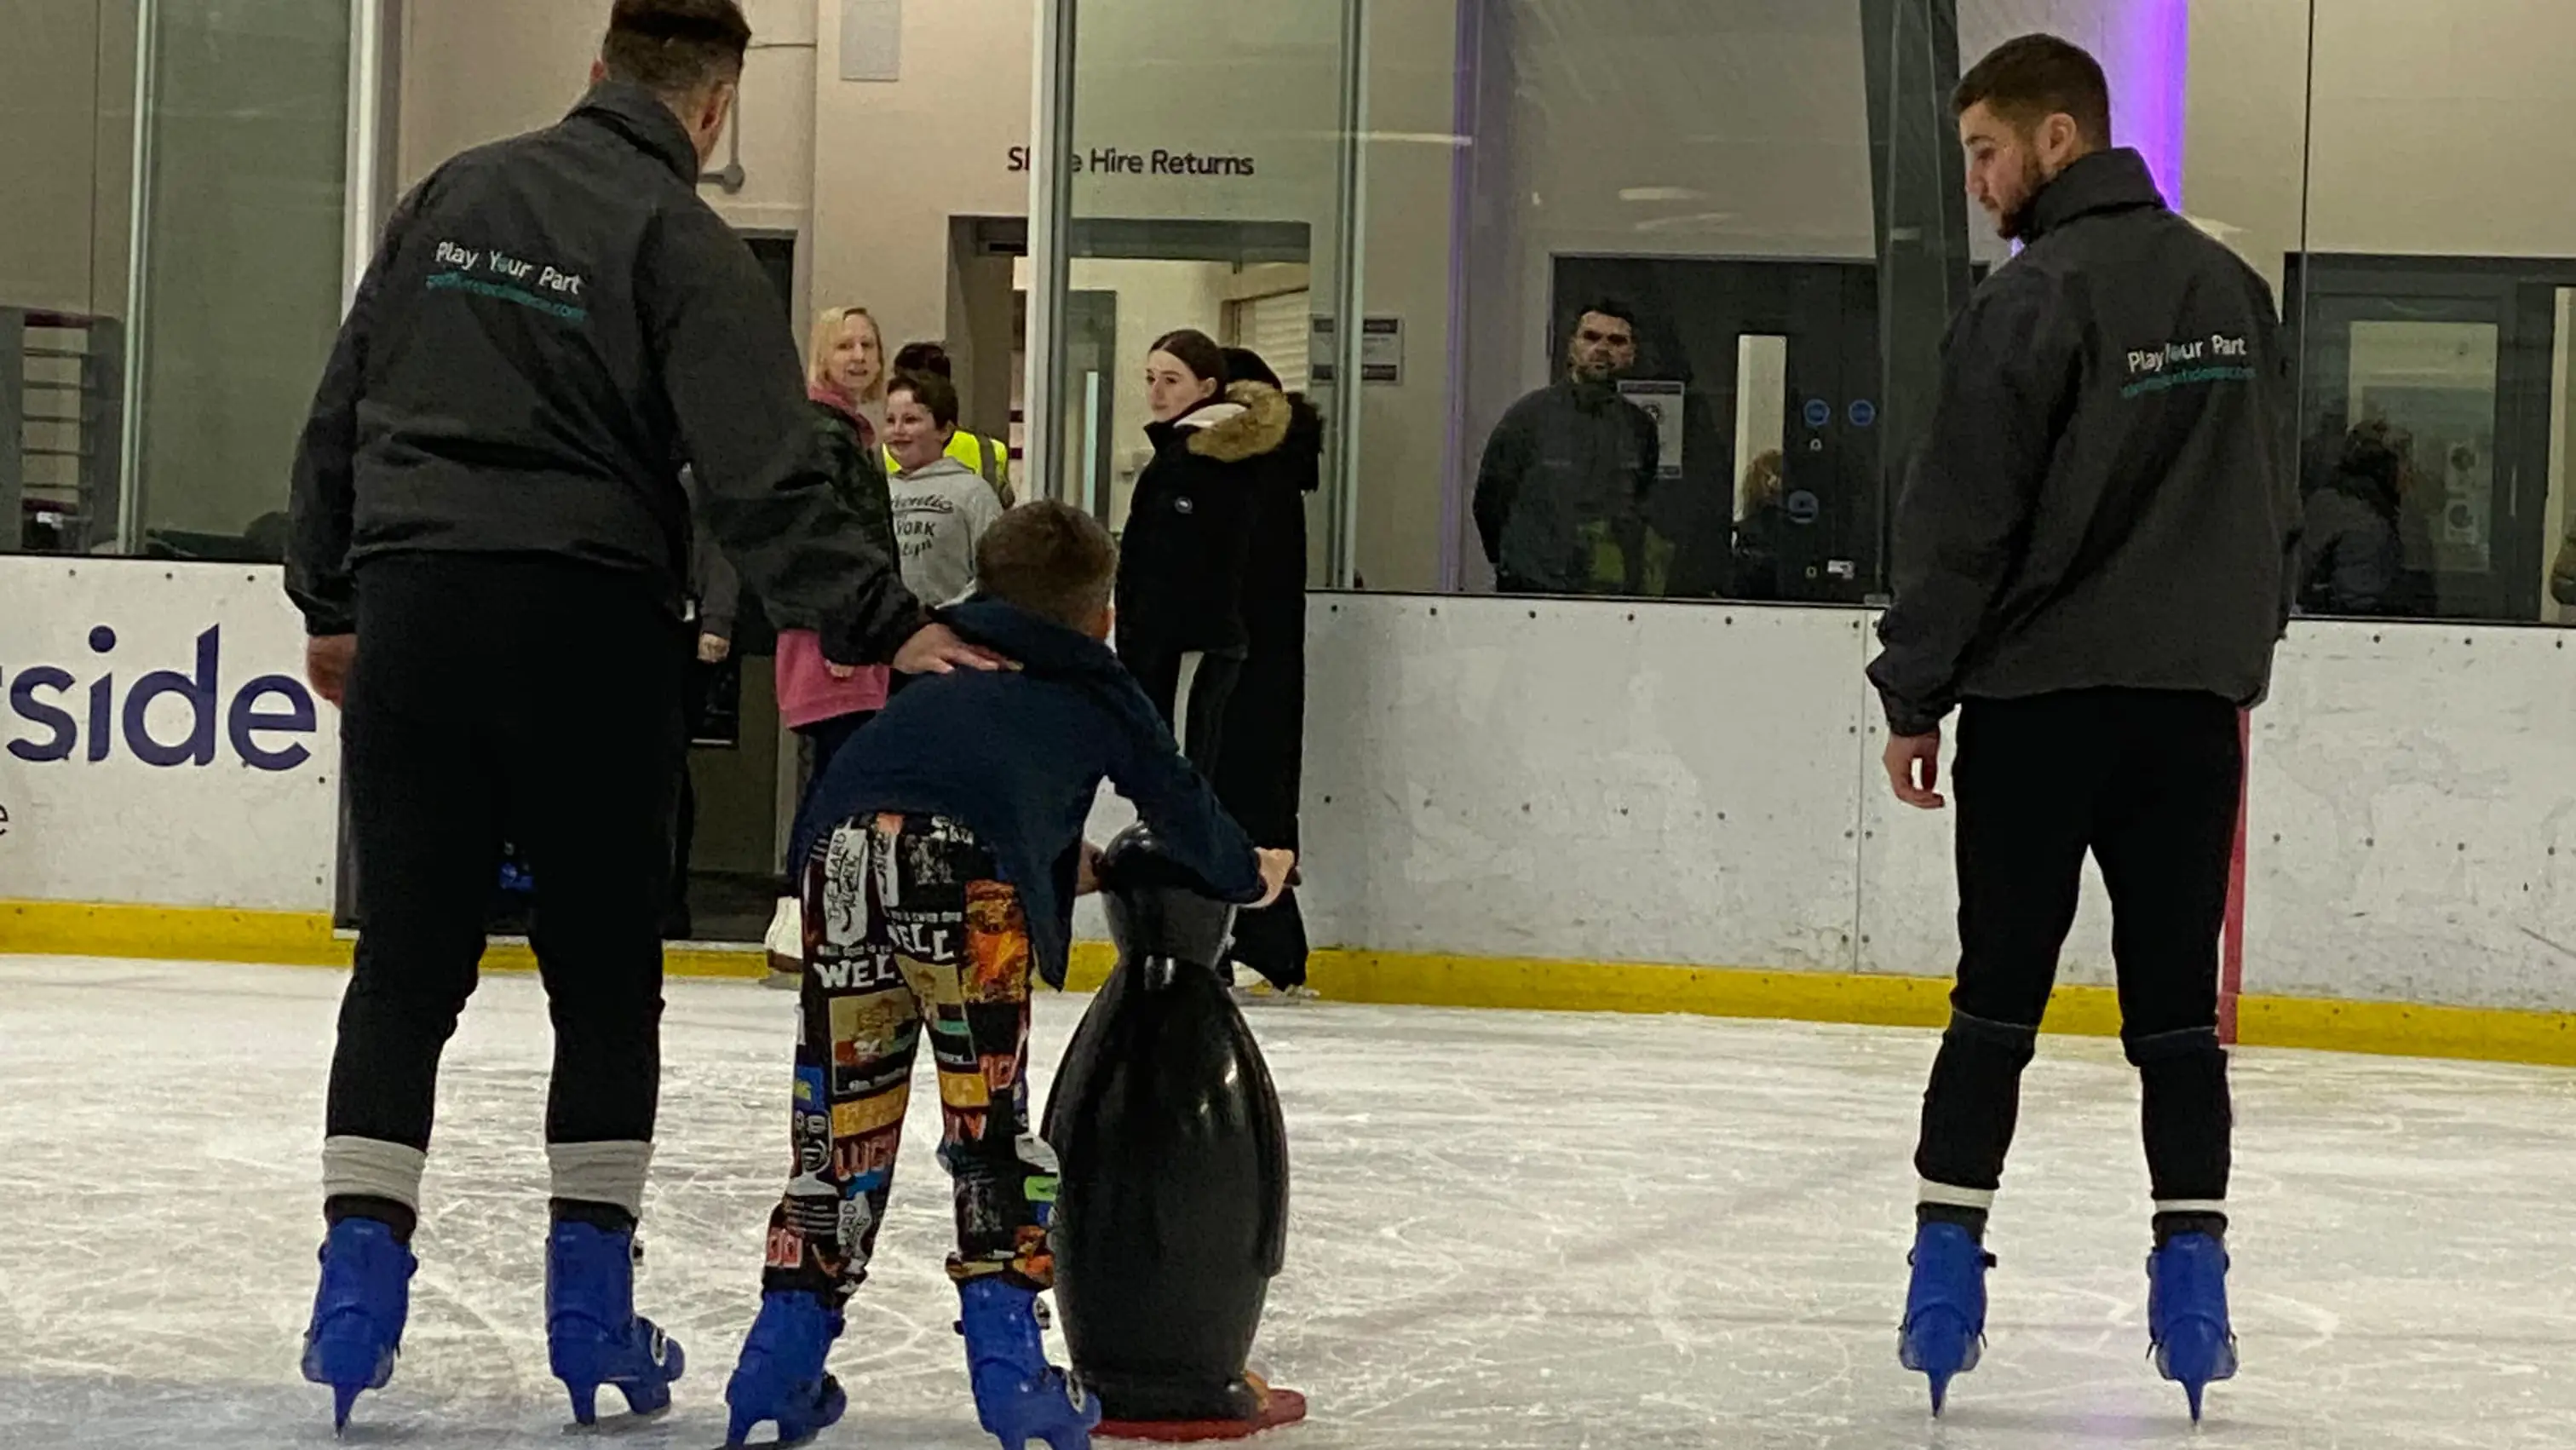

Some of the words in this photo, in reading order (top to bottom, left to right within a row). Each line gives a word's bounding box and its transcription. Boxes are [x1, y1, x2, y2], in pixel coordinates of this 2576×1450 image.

[1090, 147, 1143, 174] Hire
[1152, 149, 1255, 175] Returns
[435, 241, 479, 270] Play
[538, 266, 582, 295] Part
[2127, 350, 2165, 372] Play
[2211, 334, 2246, 356] Part
[0, 623, 317, 772] side
[812, 953, 905, 988] WEL
